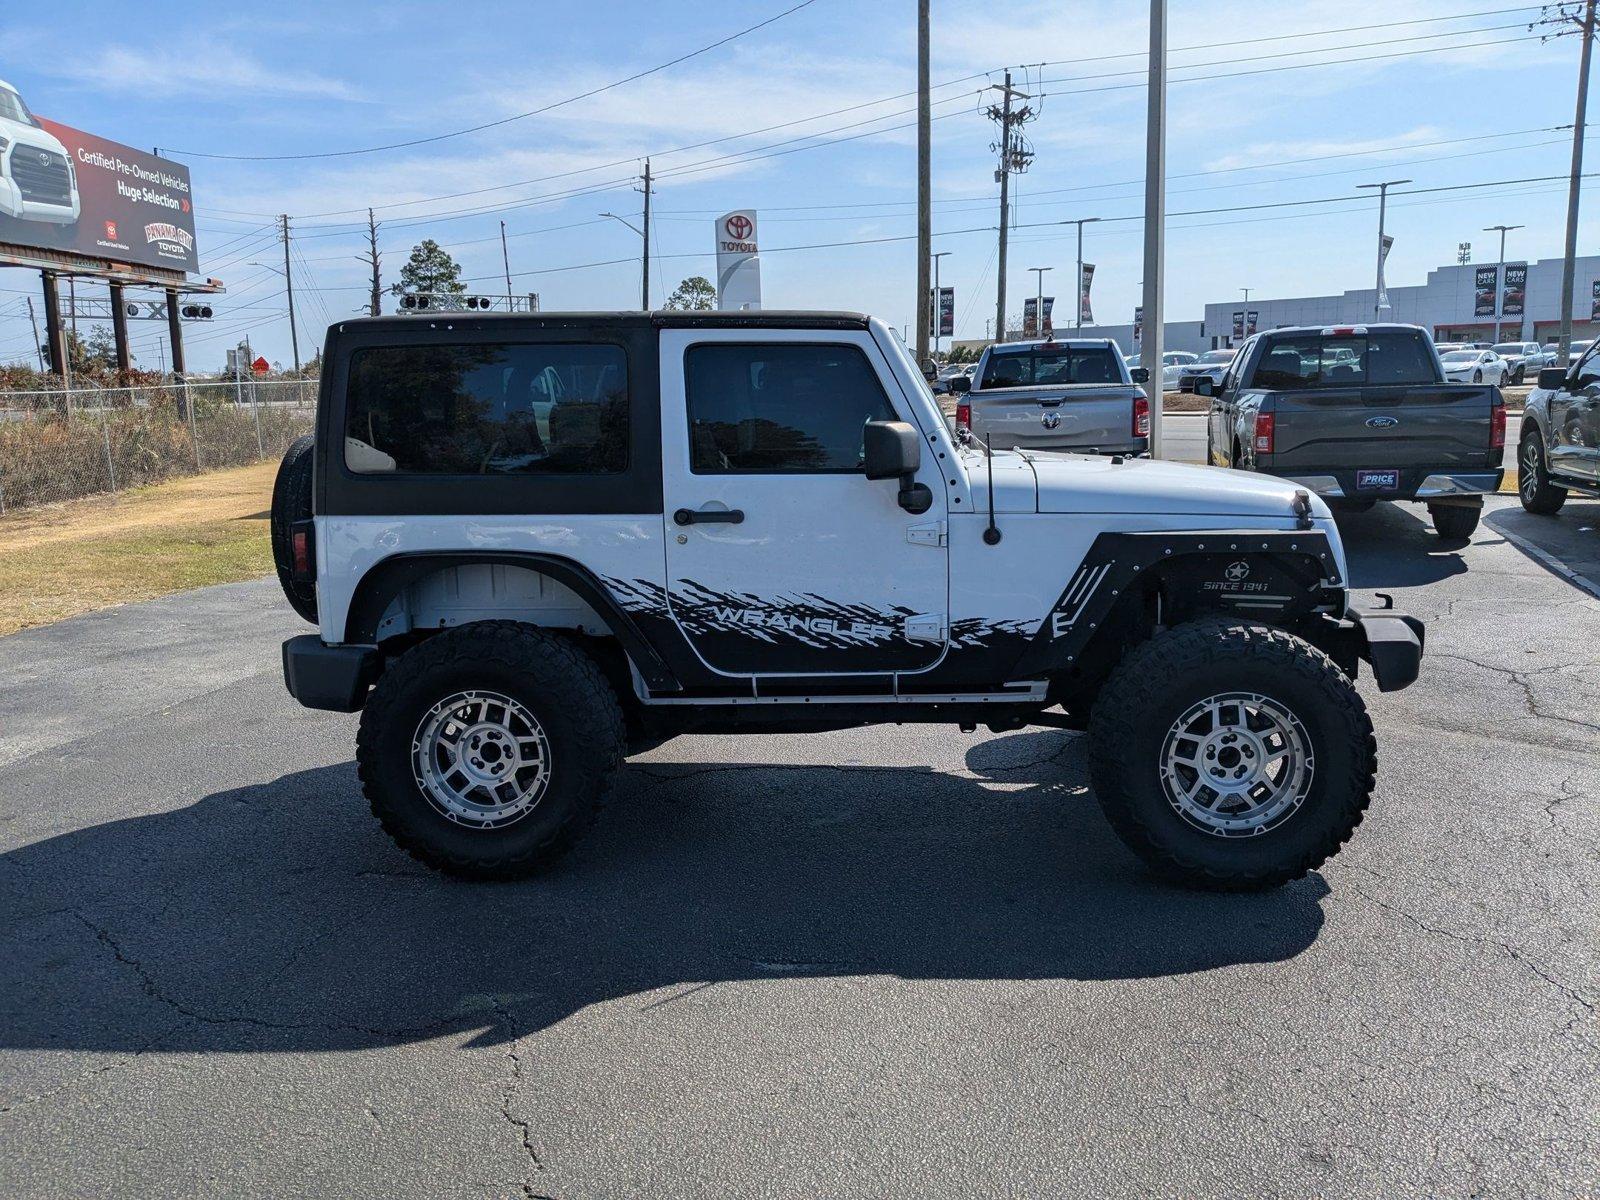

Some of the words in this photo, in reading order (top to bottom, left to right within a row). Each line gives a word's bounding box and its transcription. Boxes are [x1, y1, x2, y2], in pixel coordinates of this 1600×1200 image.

[78, 148, 115, 171] Certified
[116, 159, 160, 184] Pre-Owned
[160, 172, 189, 192] Vehicles
[117, 180, 142, 202] Huge
[142, 187, 180, 210] Selection
[144, 222, 179, 243] PANAMA
[157, 241, 185, 254] TOYOTA
[720, 241, 758, 253] TOYOTA
[1477, 271, 1496, 279] NEW
[1507, 270, 1525, 278] NEW
[1372, 418, 1392, 427] Ford
[1365, 474, 1395, 483] PRICE
[1202, 581, 1241, 591] SINCE
[1243, 582, 1269, 592] 1941
[709, 605, 893, 641] WRANGLER
